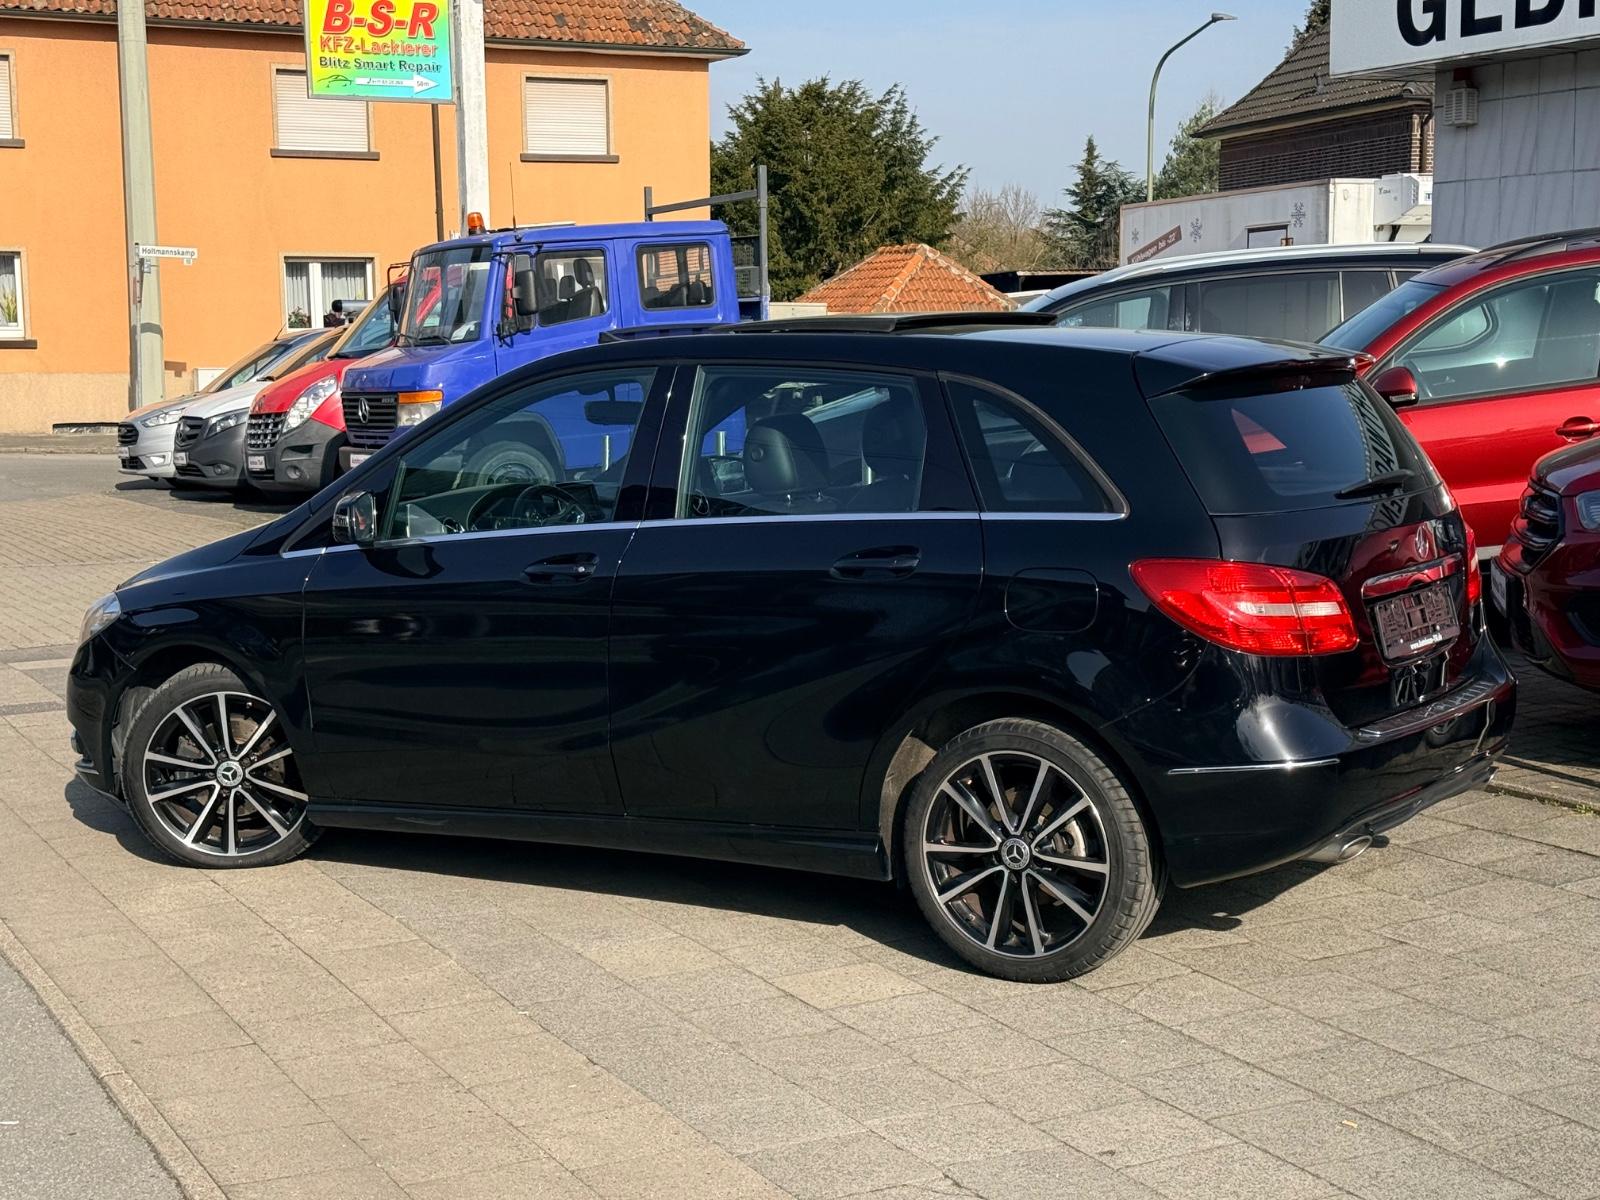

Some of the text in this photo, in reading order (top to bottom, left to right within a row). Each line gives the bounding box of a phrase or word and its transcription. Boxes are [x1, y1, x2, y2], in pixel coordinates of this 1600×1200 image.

[322, 0, 439, 39] B-S-R
[319, 35, 438, 57] KFZ-Lackierer
[319, 56, 442, 74] Blitz Smart Repair
